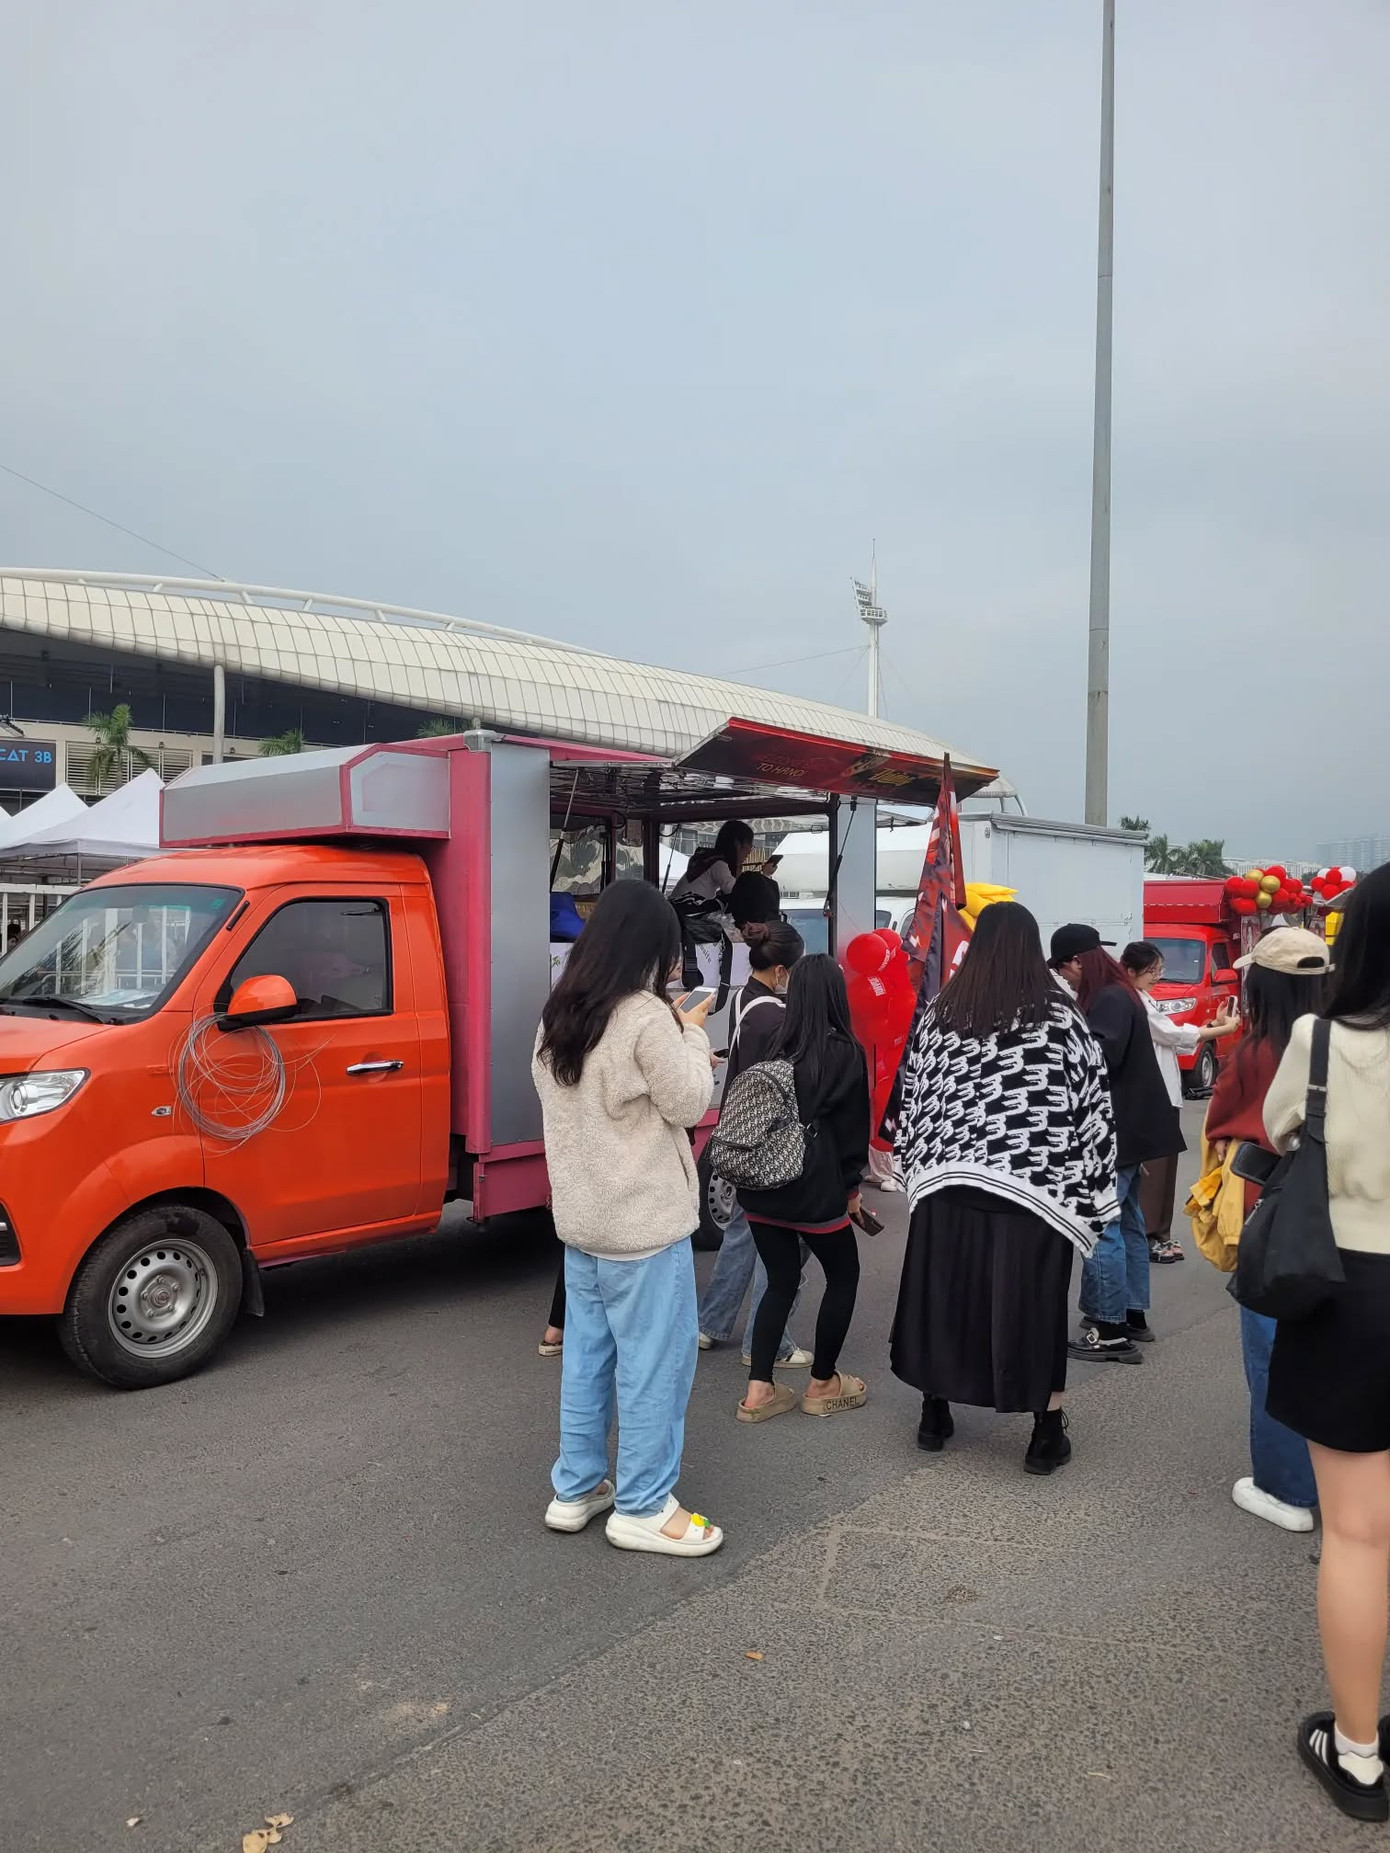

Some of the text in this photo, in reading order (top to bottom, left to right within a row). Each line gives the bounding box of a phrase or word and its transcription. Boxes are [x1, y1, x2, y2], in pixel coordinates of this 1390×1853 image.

[34, 750, 52, 764] 3B
[757, 762, 808, 777] TO HANOI
[825, 1396, 859, 1410] CHANEL
